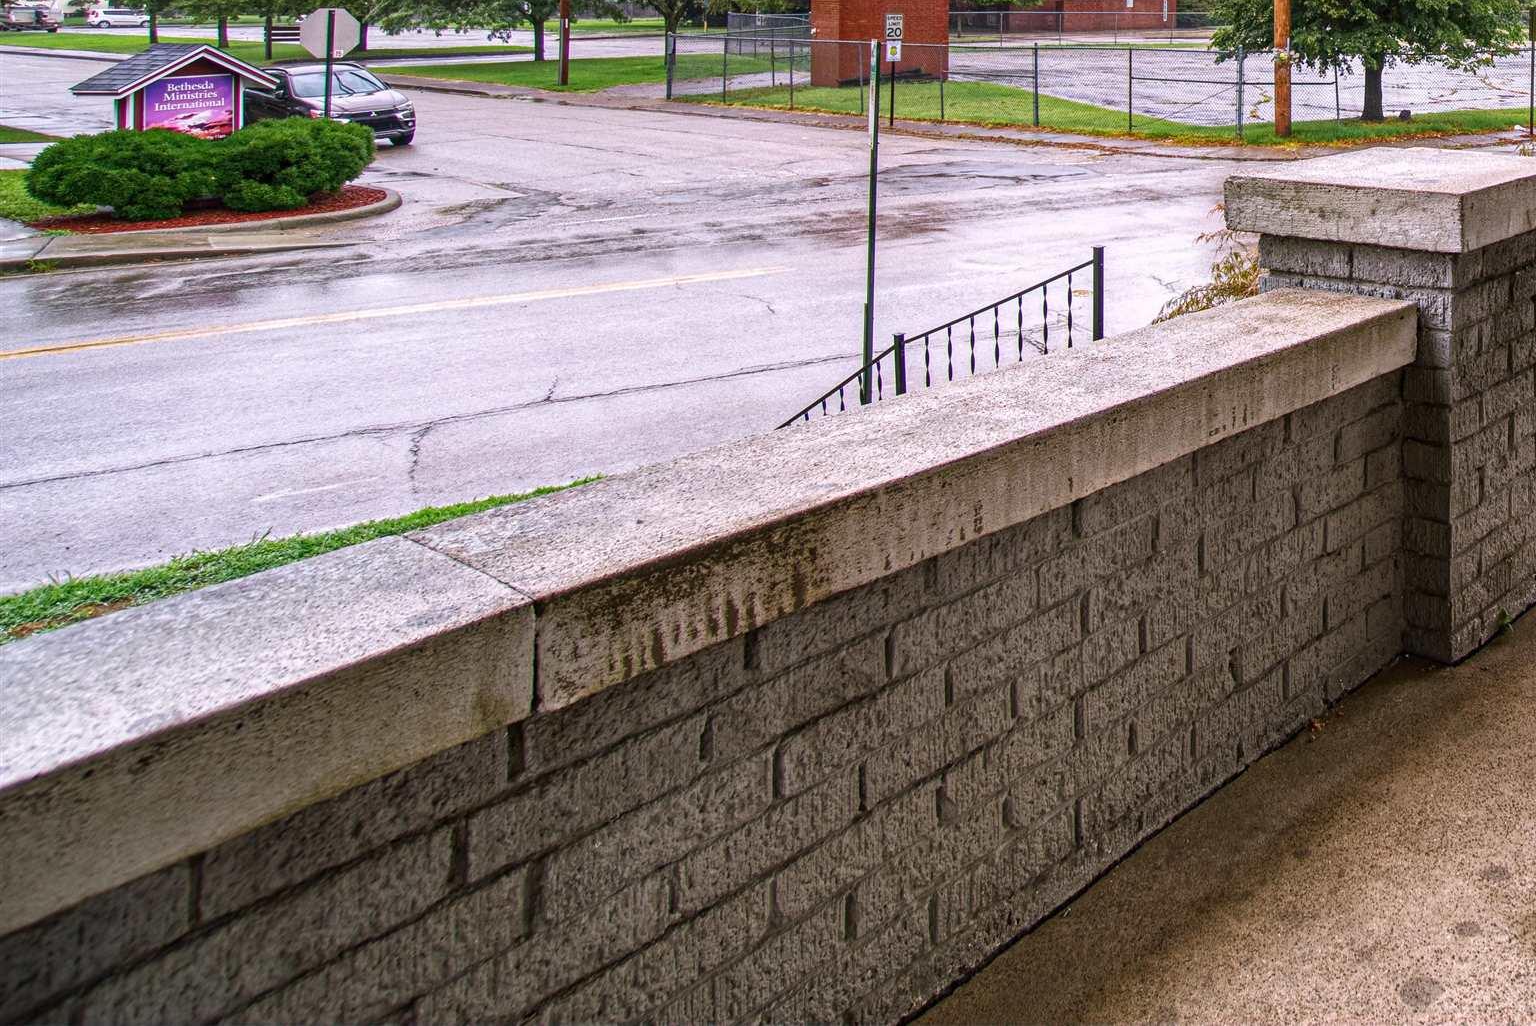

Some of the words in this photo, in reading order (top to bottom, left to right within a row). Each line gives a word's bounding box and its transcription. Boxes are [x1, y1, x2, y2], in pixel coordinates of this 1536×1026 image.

[887, 27, 902, 37] 20
[167, 81, 214, 91] Bethesda
[163, 90, 218, 101] Ministries
[153, 98, 225, 111] International
